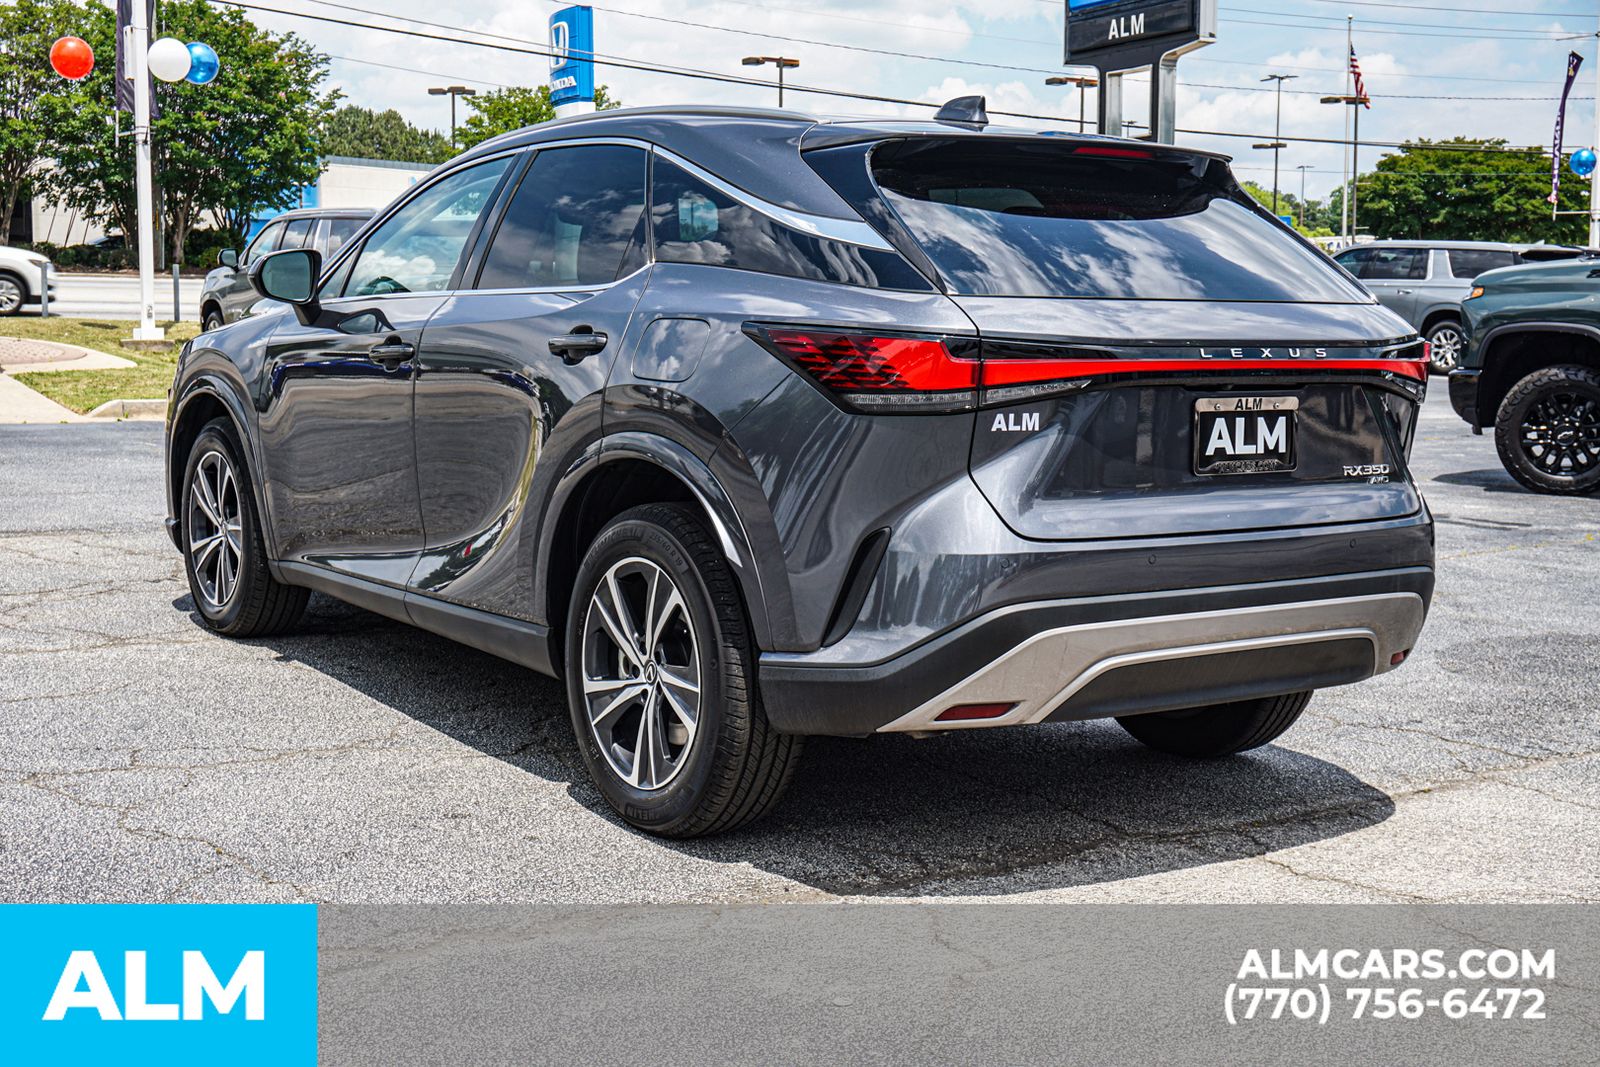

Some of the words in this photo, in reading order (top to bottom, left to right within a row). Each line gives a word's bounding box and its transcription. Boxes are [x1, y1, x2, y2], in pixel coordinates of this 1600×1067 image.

[1108, 13, 1145, 40] ALM
[1200, 348, 1327, 358] LEXUS
[1234, 398, 1263, 411] ALM
[991, 412, 1040, 431] ALM
[1205, 416, 1287, 456] ALM
